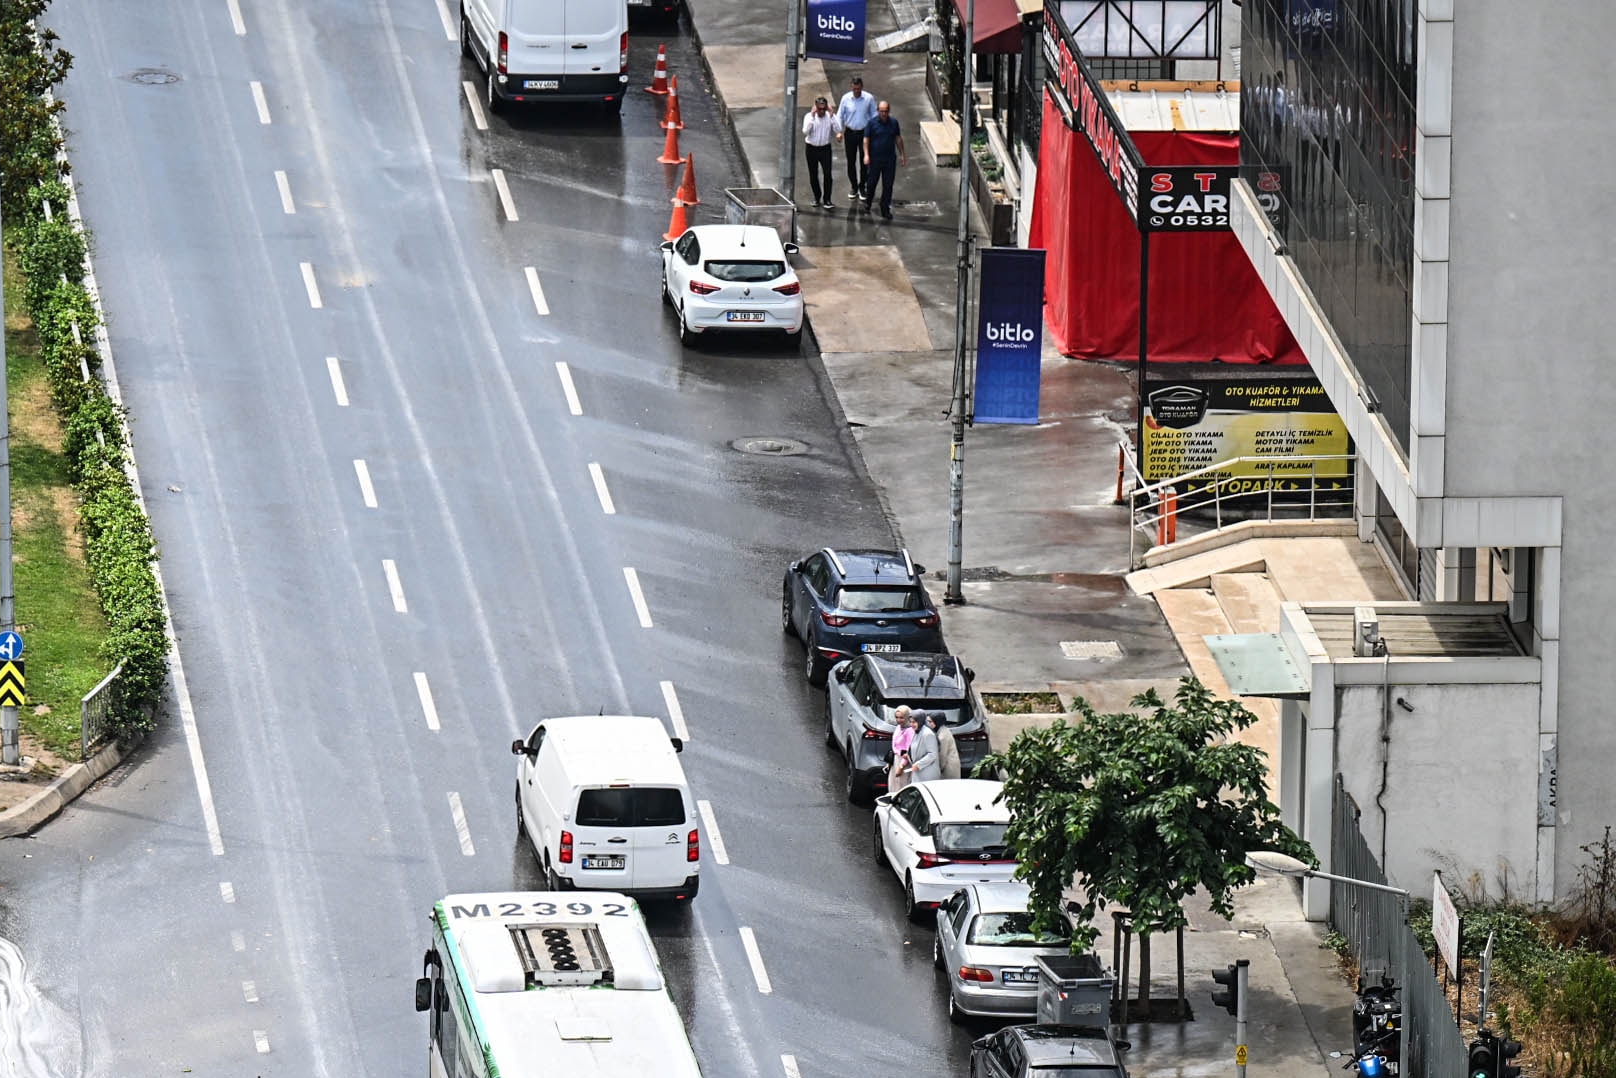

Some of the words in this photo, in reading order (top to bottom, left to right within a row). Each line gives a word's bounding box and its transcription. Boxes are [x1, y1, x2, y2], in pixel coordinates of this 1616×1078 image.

[817, 14, 855, 31] bitlo
[1059, 38, 1082, 111] OTO
[1150, 195, 1227, 213] CAR
[1170, 215, 1227, 226] 0532
[986, 322, 1034, 342] bitlo
[1225, 387, 1244, 396] OTO
[1245, 384, 1280, 396] KUAFÖR
[1291, 386, 1324, 395] YIKAMA
[1249, 396, 1300, 407] HİZMETLERİ
[1298, 429, 1333, 437] TEMİZLİK
[1277, 462, 1313, 470] KAPLAMA
[451, 902, 629, 919] M2392
